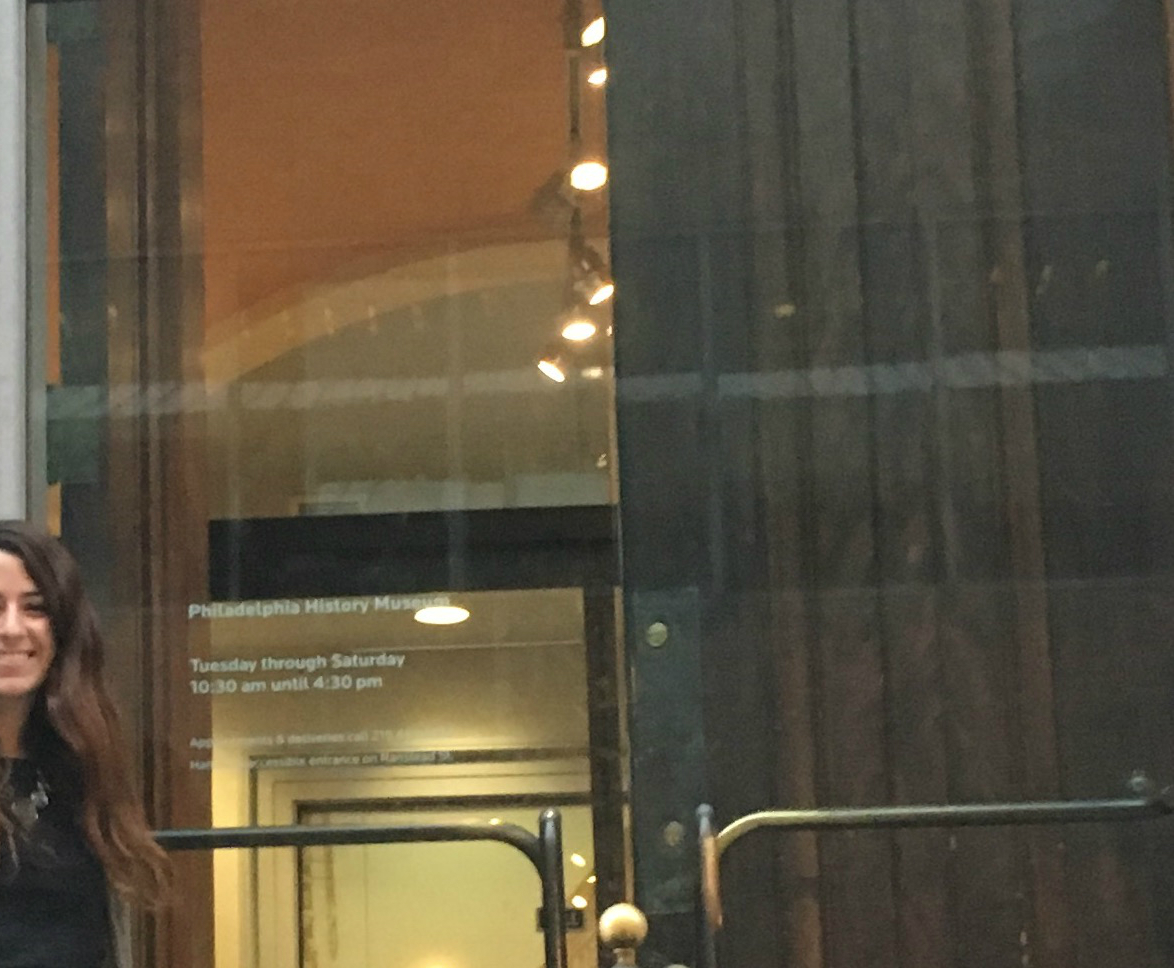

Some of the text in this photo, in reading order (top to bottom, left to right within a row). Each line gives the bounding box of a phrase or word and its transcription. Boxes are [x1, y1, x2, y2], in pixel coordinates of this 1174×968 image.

[188, 595, 451, 619] Philadelphia History Museum
[190, 652, 405, 673] Tuesday through Saturday
[190, 675, 383, 694] 10:30 am until 4:30 pm
